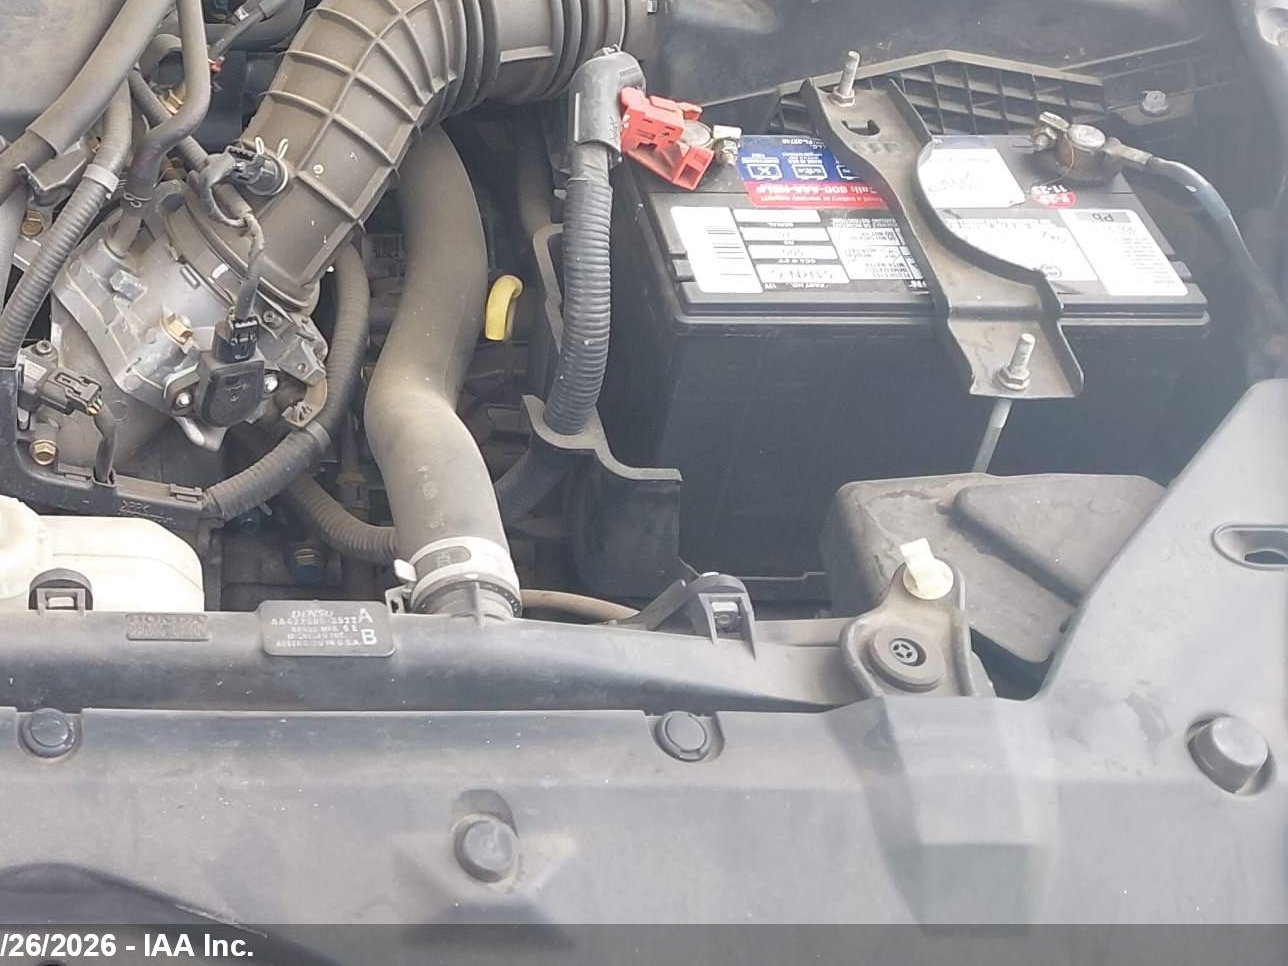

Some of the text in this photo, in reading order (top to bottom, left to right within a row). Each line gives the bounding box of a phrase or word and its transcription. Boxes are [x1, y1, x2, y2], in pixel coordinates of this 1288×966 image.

[1092, 213, 1114, 222] Pb
[358, 608, 374, 624] A
[361, 629, 378, 645] B
